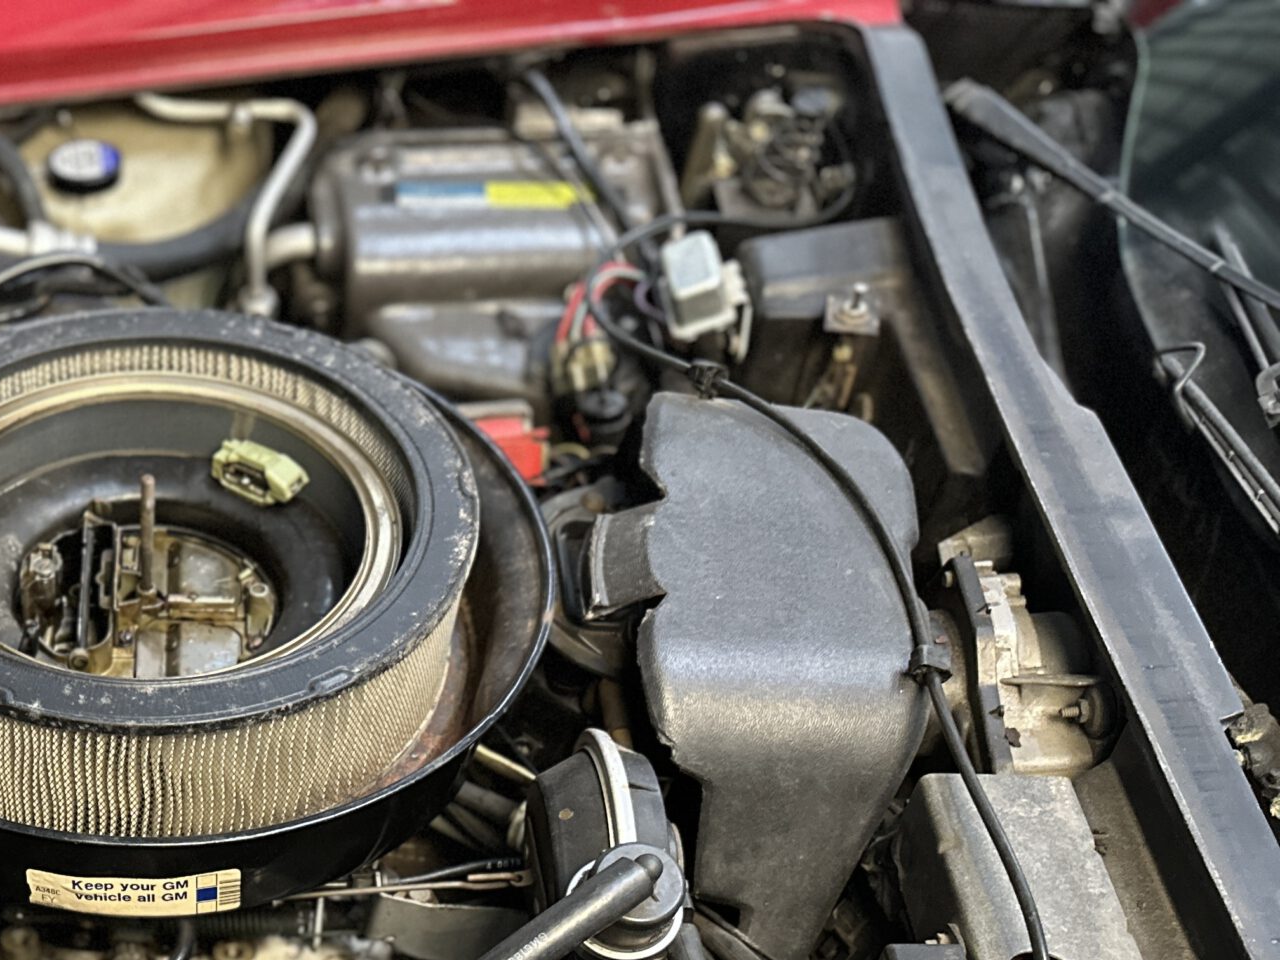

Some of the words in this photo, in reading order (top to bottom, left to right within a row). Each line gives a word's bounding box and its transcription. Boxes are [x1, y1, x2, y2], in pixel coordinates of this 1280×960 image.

[72, 879, 114, 891] Keep
[120, 883, 156, 892] your
[162, 880, 189, 890] GM
[75, 892, 132, 902] vehicle
[137, 893, 156, 902] all
[161, 891, 187, 901] GM
